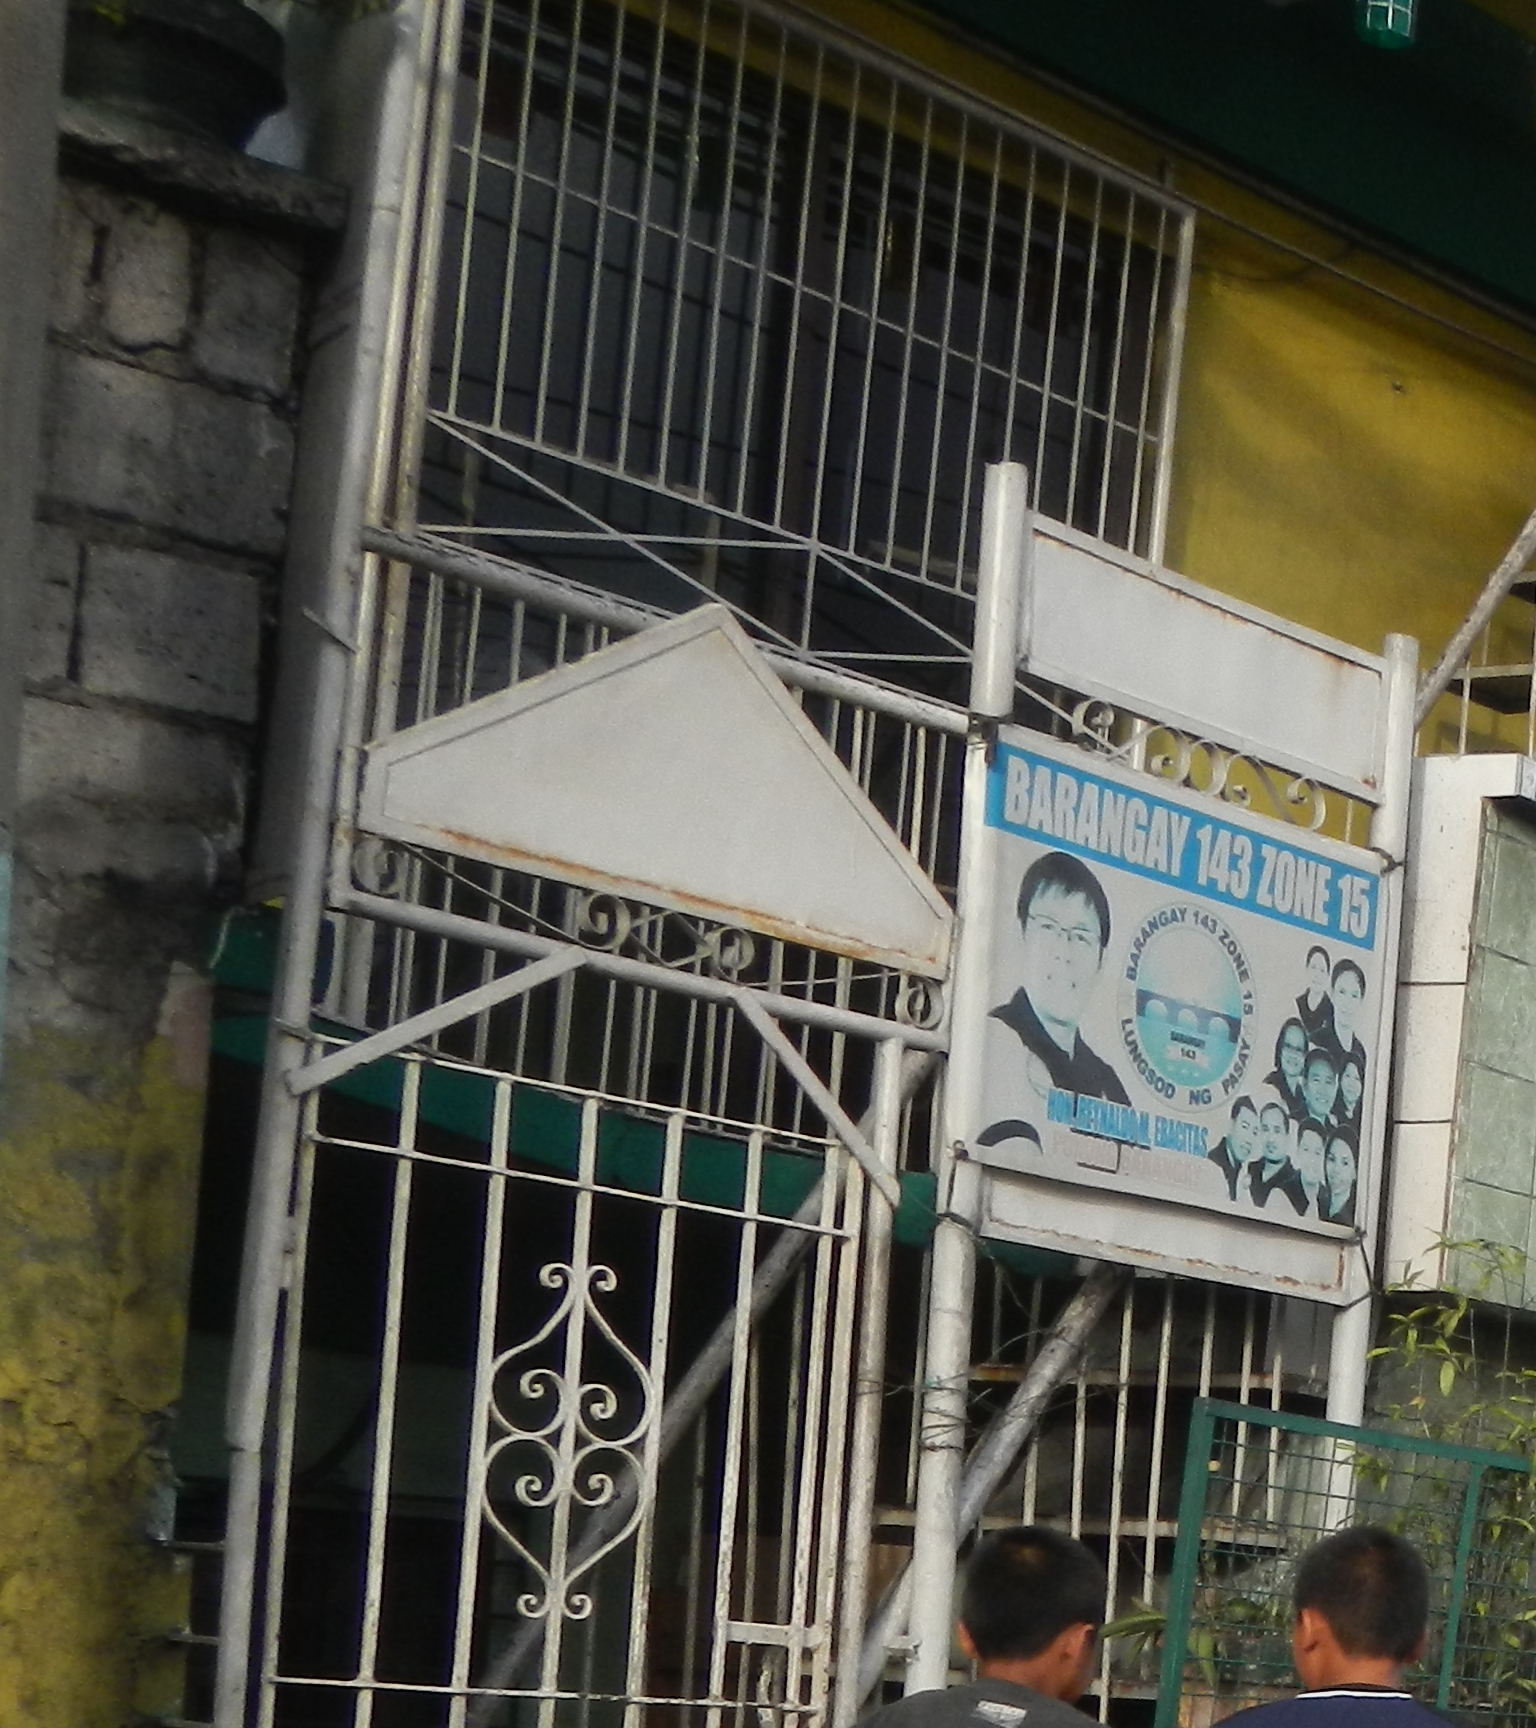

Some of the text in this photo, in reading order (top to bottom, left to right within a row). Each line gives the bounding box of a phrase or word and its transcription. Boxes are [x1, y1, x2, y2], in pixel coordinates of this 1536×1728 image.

[1004, 755, 1372, 939] BARANGAY 143 ZONE 15
[1126, 907, 1188, 981] BARANGAY
[1192, 910, 1219, 935] 143
[1218, 929, 1250, 984] ZONE
[1121, 1018, 1251, 1106] LUNGSOD NG PASAY
